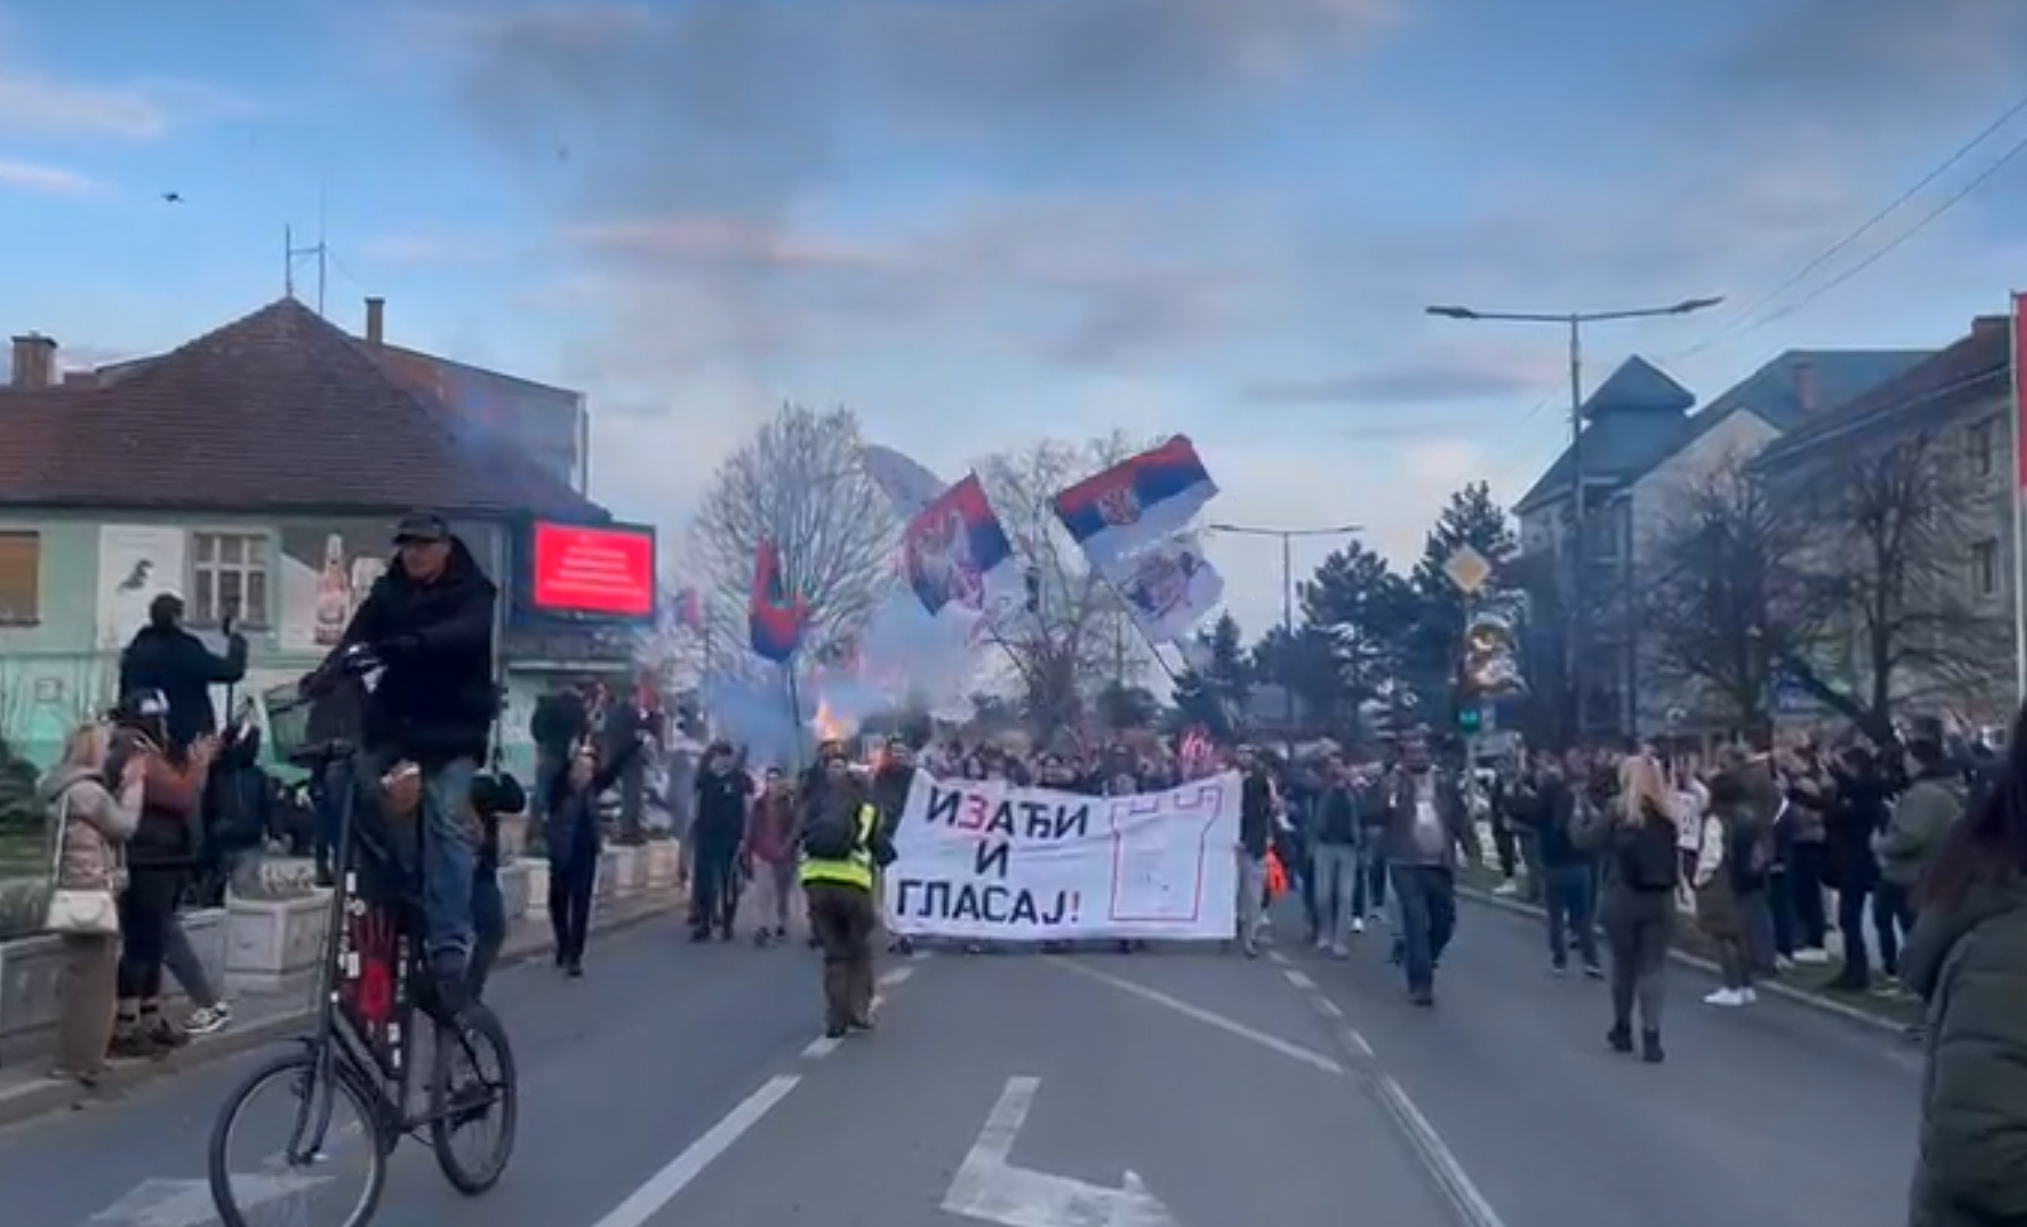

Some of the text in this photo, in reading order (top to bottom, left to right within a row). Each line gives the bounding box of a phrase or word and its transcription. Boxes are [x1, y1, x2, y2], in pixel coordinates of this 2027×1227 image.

[926, 786, 1089, 838] ИЗАЂИ
[974, 840, 1010, 878] И
[896, 879, 1081, 925] ГЛАСАЈ!
